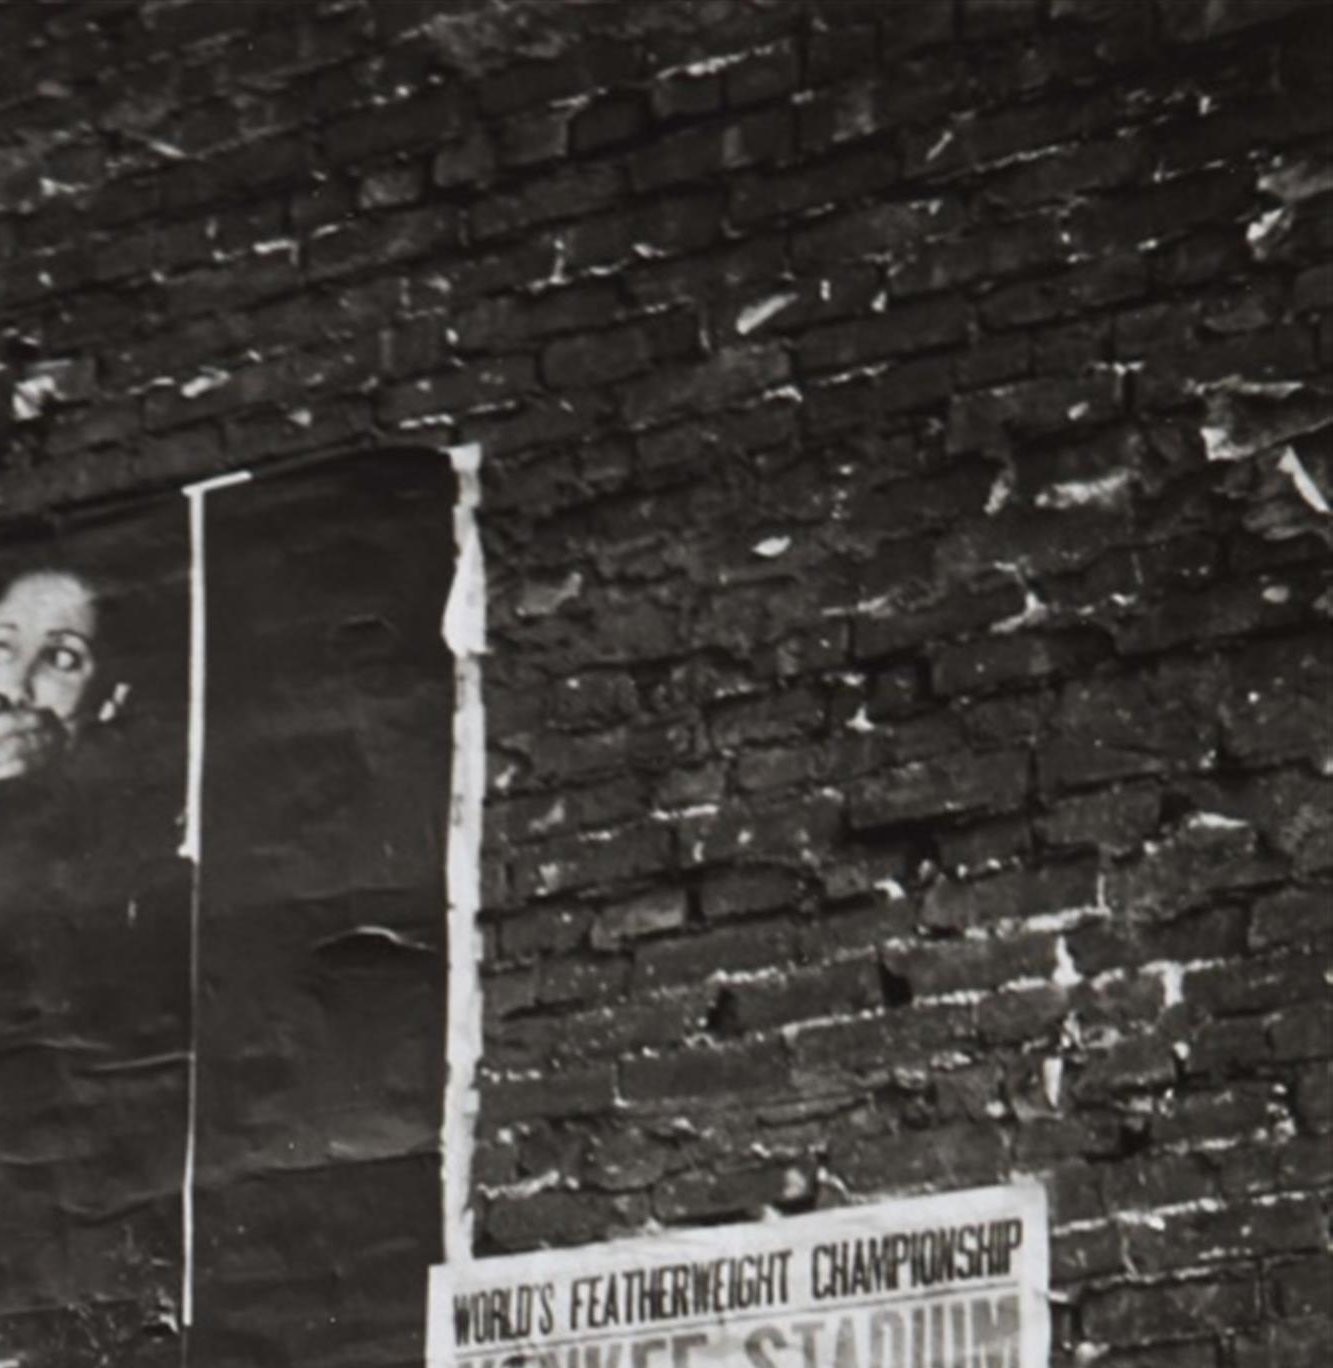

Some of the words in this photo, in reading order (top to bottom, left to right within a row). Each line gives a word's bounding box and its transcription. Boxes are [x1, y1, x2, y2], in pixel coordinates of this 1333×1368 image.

[454, 1283, 555, 1346] WORLD'S
[570, 1249, 793, 1331] FEATHERWEIGHT
[811, 1218, 1023, 1299] CHAMPIONSHIP
